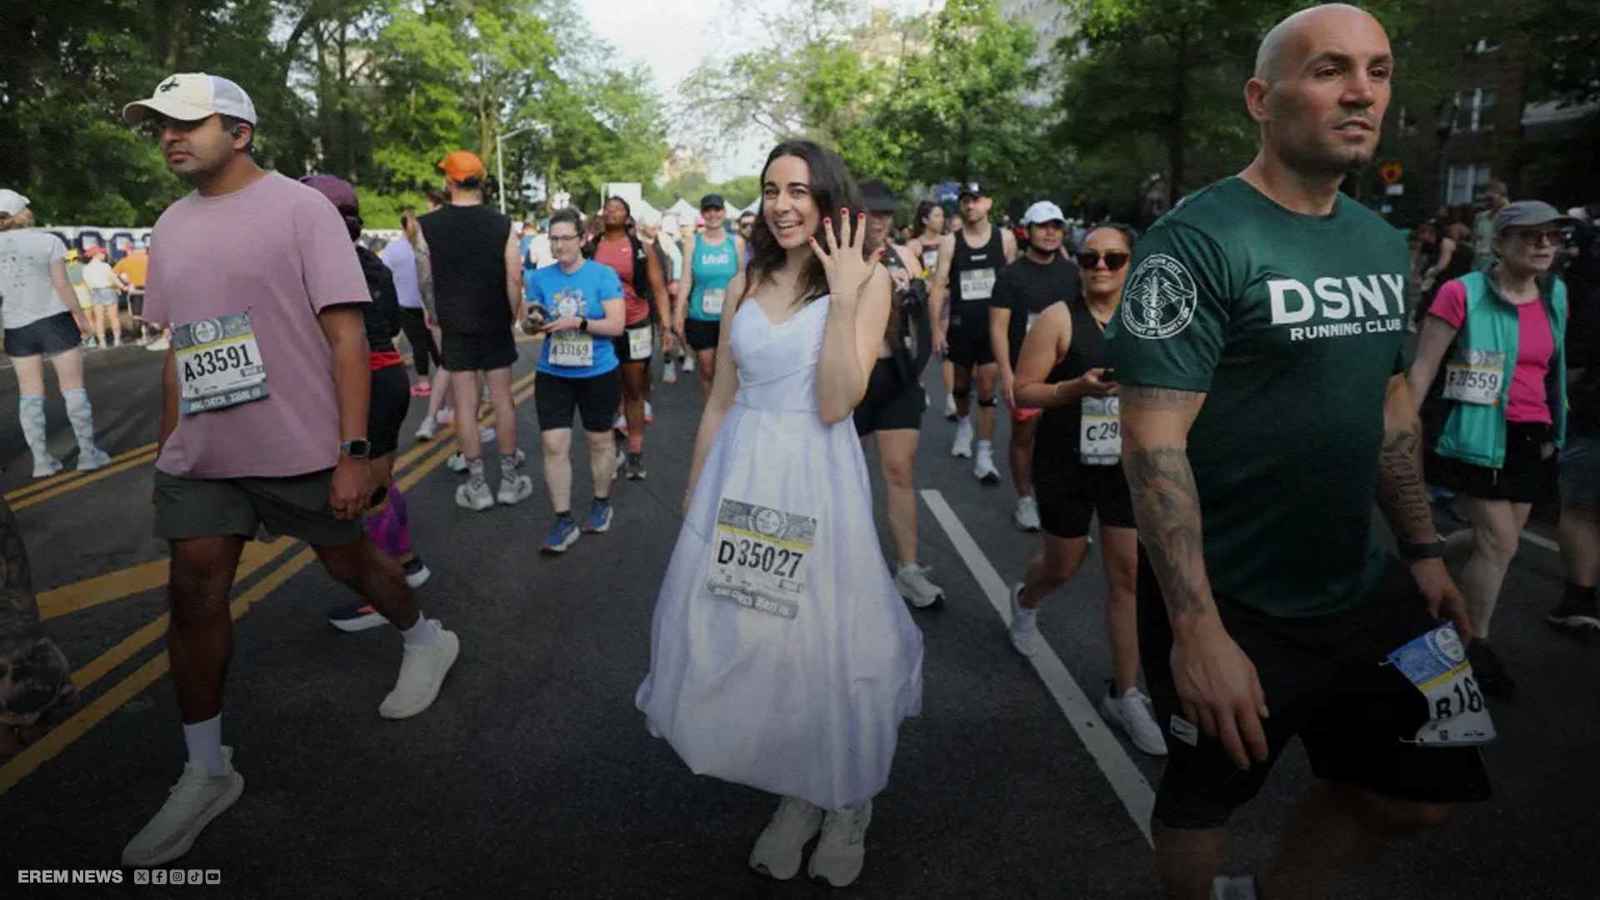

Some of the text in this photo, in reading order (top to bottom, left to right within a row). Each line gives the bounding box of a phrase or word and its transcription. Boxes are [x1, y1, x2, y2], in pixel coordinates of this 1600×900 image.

[1266, 273, 1405, 325] DSNY
[1289, 318, 1402, 341] RUNNING CLUB
[184, 344, 254, 382] A33591
[717, 539, 804, 579] D35027
